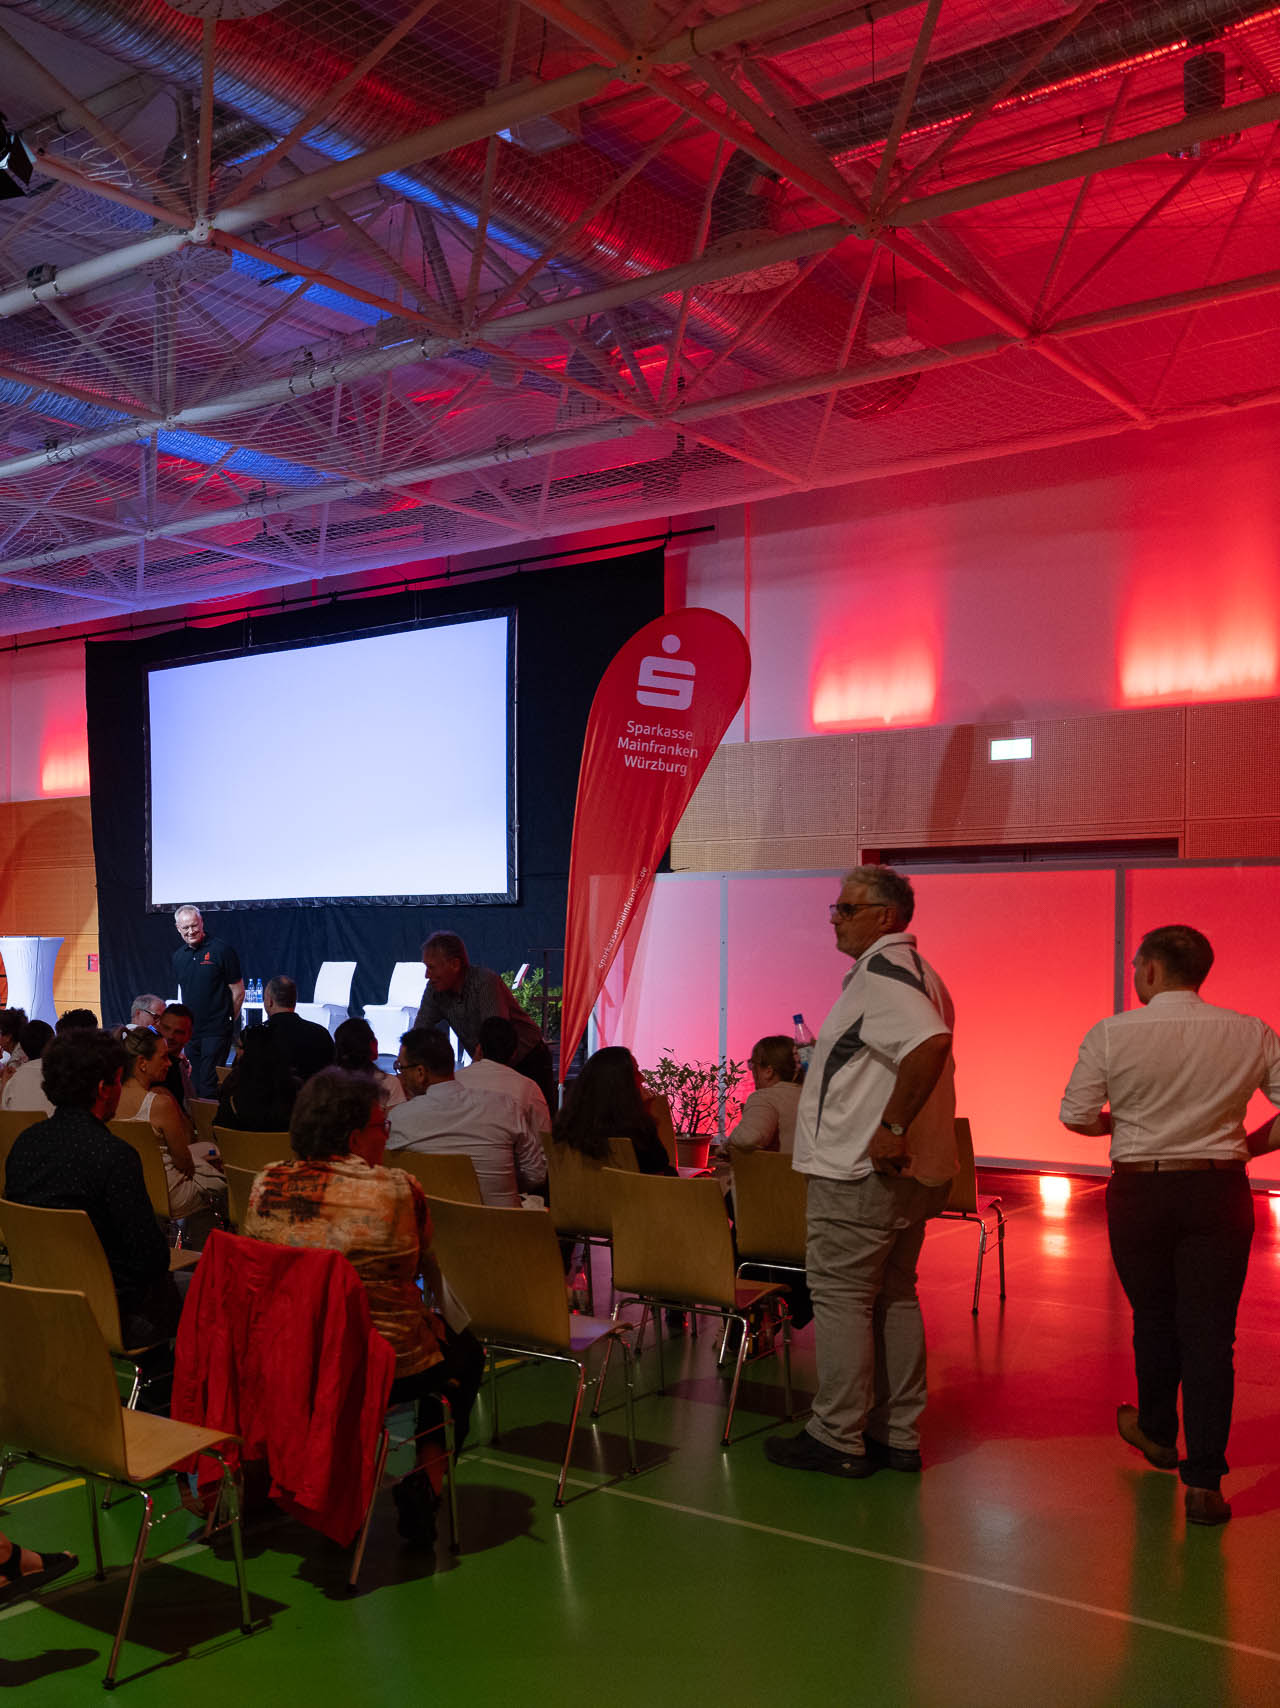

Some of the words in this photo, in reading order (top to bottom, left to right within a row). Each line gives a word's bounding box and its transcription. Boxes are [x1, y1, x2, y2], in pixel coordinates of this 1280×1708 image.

[626, 720, 693, 741] Sparkasse
[617, 737, 698, 758] Mainfranken
[624, 754, 688, 776] Würzburg
